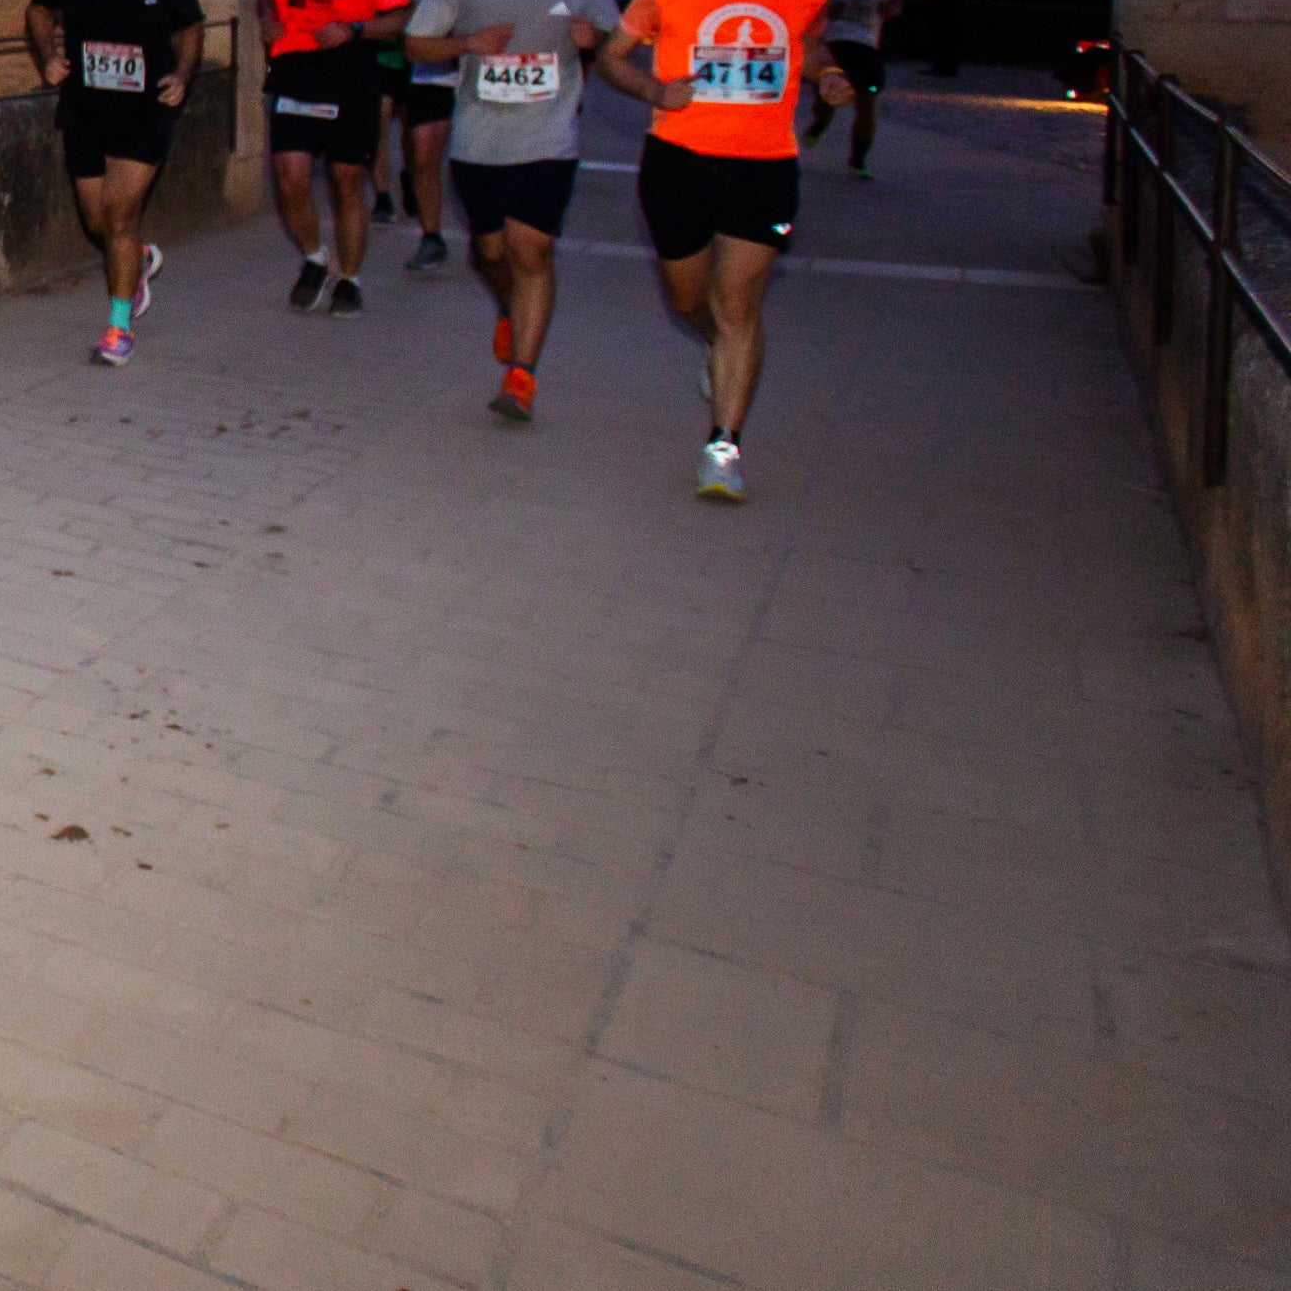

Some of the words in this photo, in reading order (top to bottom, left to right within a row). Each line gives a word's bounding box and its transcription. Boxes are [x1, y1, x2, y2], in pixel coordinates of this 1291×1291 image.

[86, 54, 136, 76] 3510
[484, 65, 546, 85] 4462
[699, 62, 775, 85] 4714
